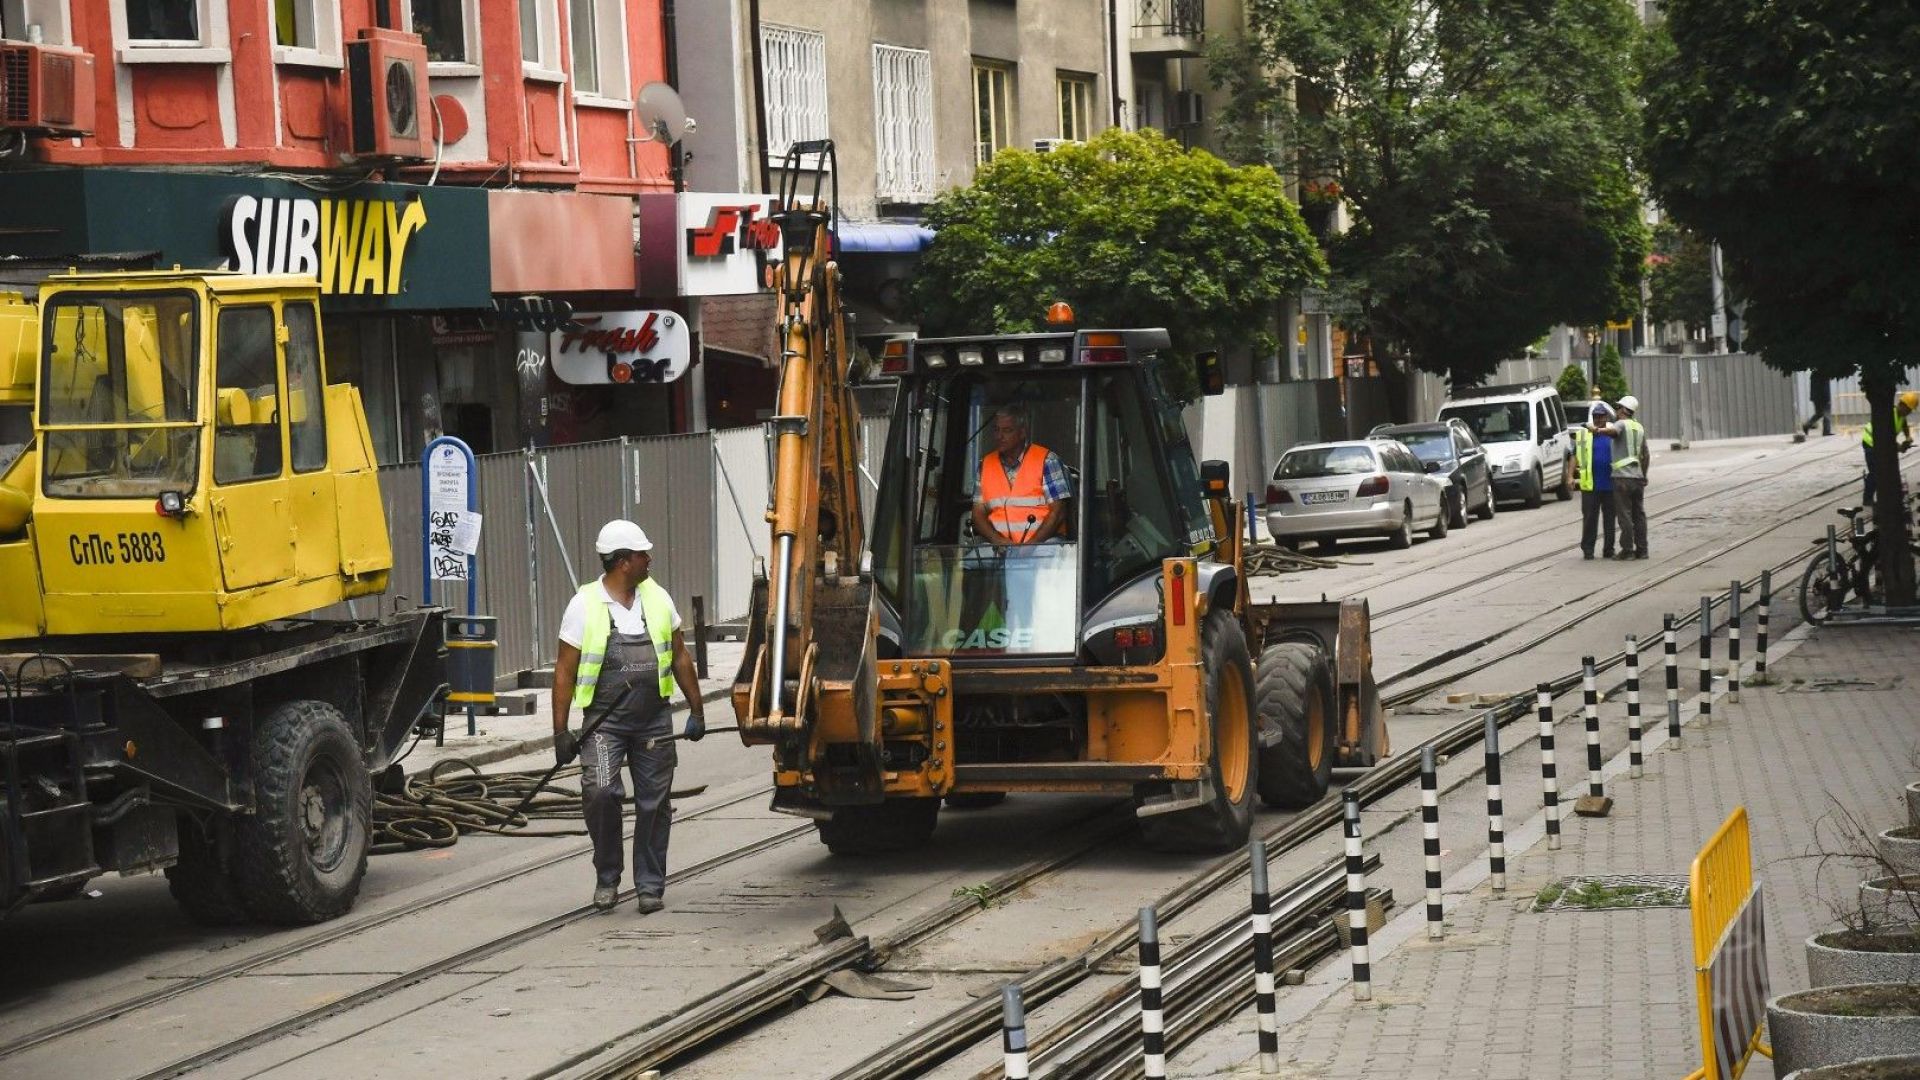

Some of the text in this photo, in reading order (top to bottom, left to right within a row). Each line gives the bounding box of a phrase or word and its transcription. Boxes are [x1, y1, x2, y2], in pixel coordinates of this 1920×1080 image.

[231, 193, 428, 295] SUBWAY
[560, 312, 660, 354] Fresh
[117, 531, 166, 563] 5883
[942, 627, 1034, 649] CASE
